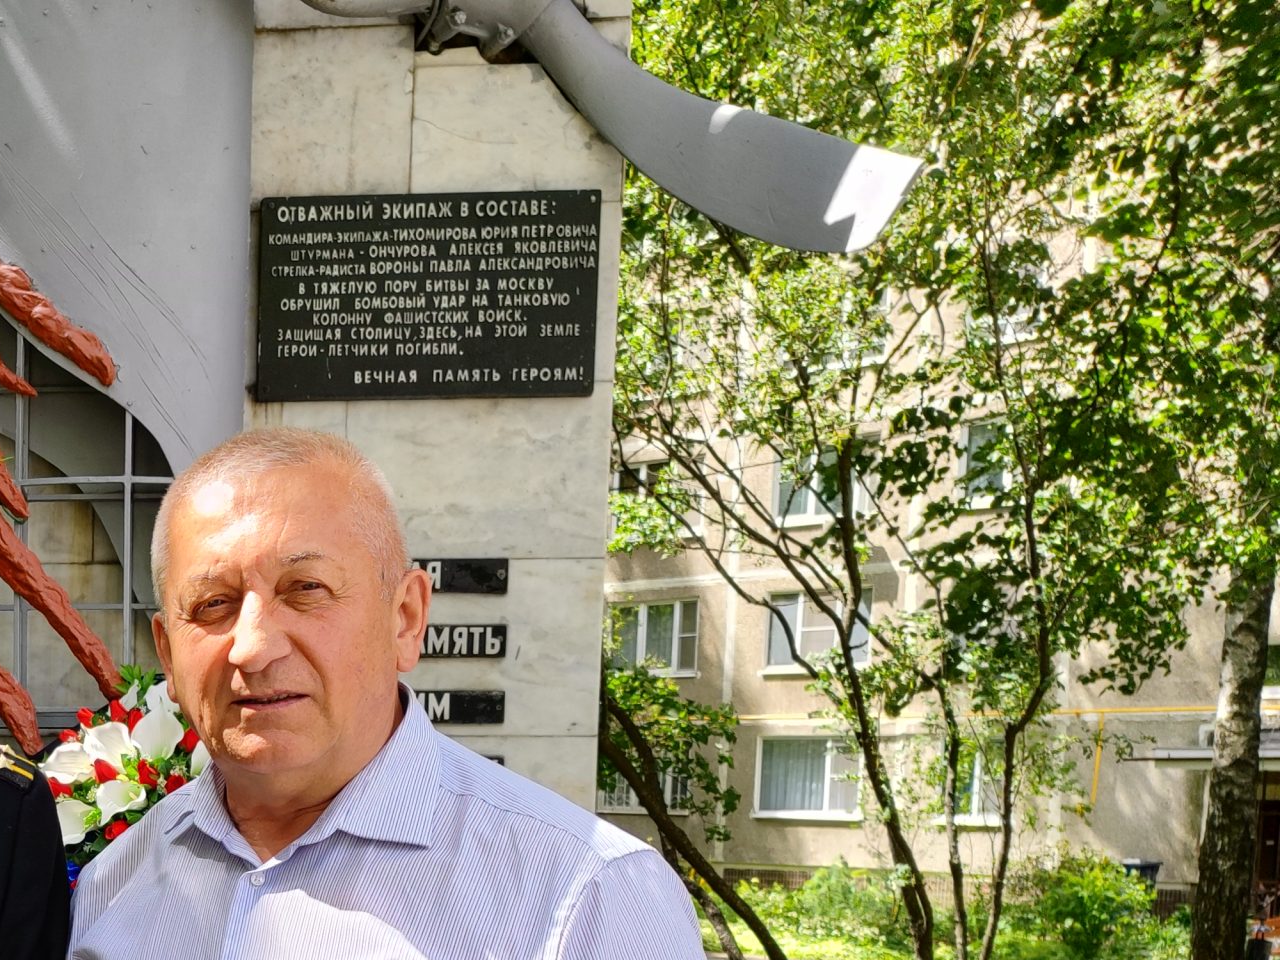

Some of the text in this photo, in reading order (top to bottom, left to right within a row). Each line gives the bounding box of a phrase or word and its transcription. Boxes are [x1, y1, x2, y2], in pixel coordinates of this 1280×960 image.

[277, 200, 556, 222] ОТВАЖНЫЙ ЭКИПАЖ В СОСТАВЕ:
[481, 226, 518, 240] ЮРИЯ
[522, 224, 597, 239] ПЕТРОВИЧА
[291, 249, 355, 261] ШТУРМАНА
[369, 244, 436, 258] ОНЧУРОВА
[449, 242, 503, 255] АЛЕКСЕЯ
[514, 240, 597, 254] ЯКОВЛЕВИЧА
[271, 256, 596, 277] СТРЕЛКА-РАДИСТА ВОРОНЫ ПАВЛА АЛЕКСАНДРОВИЧА
[299, 278, 554, 294] В ТЯЖЕЛУЮ ПОРУ БИТВЫ ЗА МОСКВУ
[280, 293, 570, 311] ОБРУШИЛ БОМБОВЫЙ УДАР НА ТАНКОВУЮ
[313, 313, 372, 325] КОЛОННУ
[384, 311, 469, 324] ФАШИСТСКИХ
[277, 328, 341, 342] ЗАЩИЩАЯ
[495, 323, 527, 337] ЭТОЙ
[540, 323, 580, 337] ЗЕМЛЕ
[396, 342, 463, 356] ПОГИБЛИ.
[354, 366, 584, 384] ВЕЧНАЯ ПАМЯТЬ ГЕРОЯМ!
[420, 627, 501, 655] МЯТЬ
